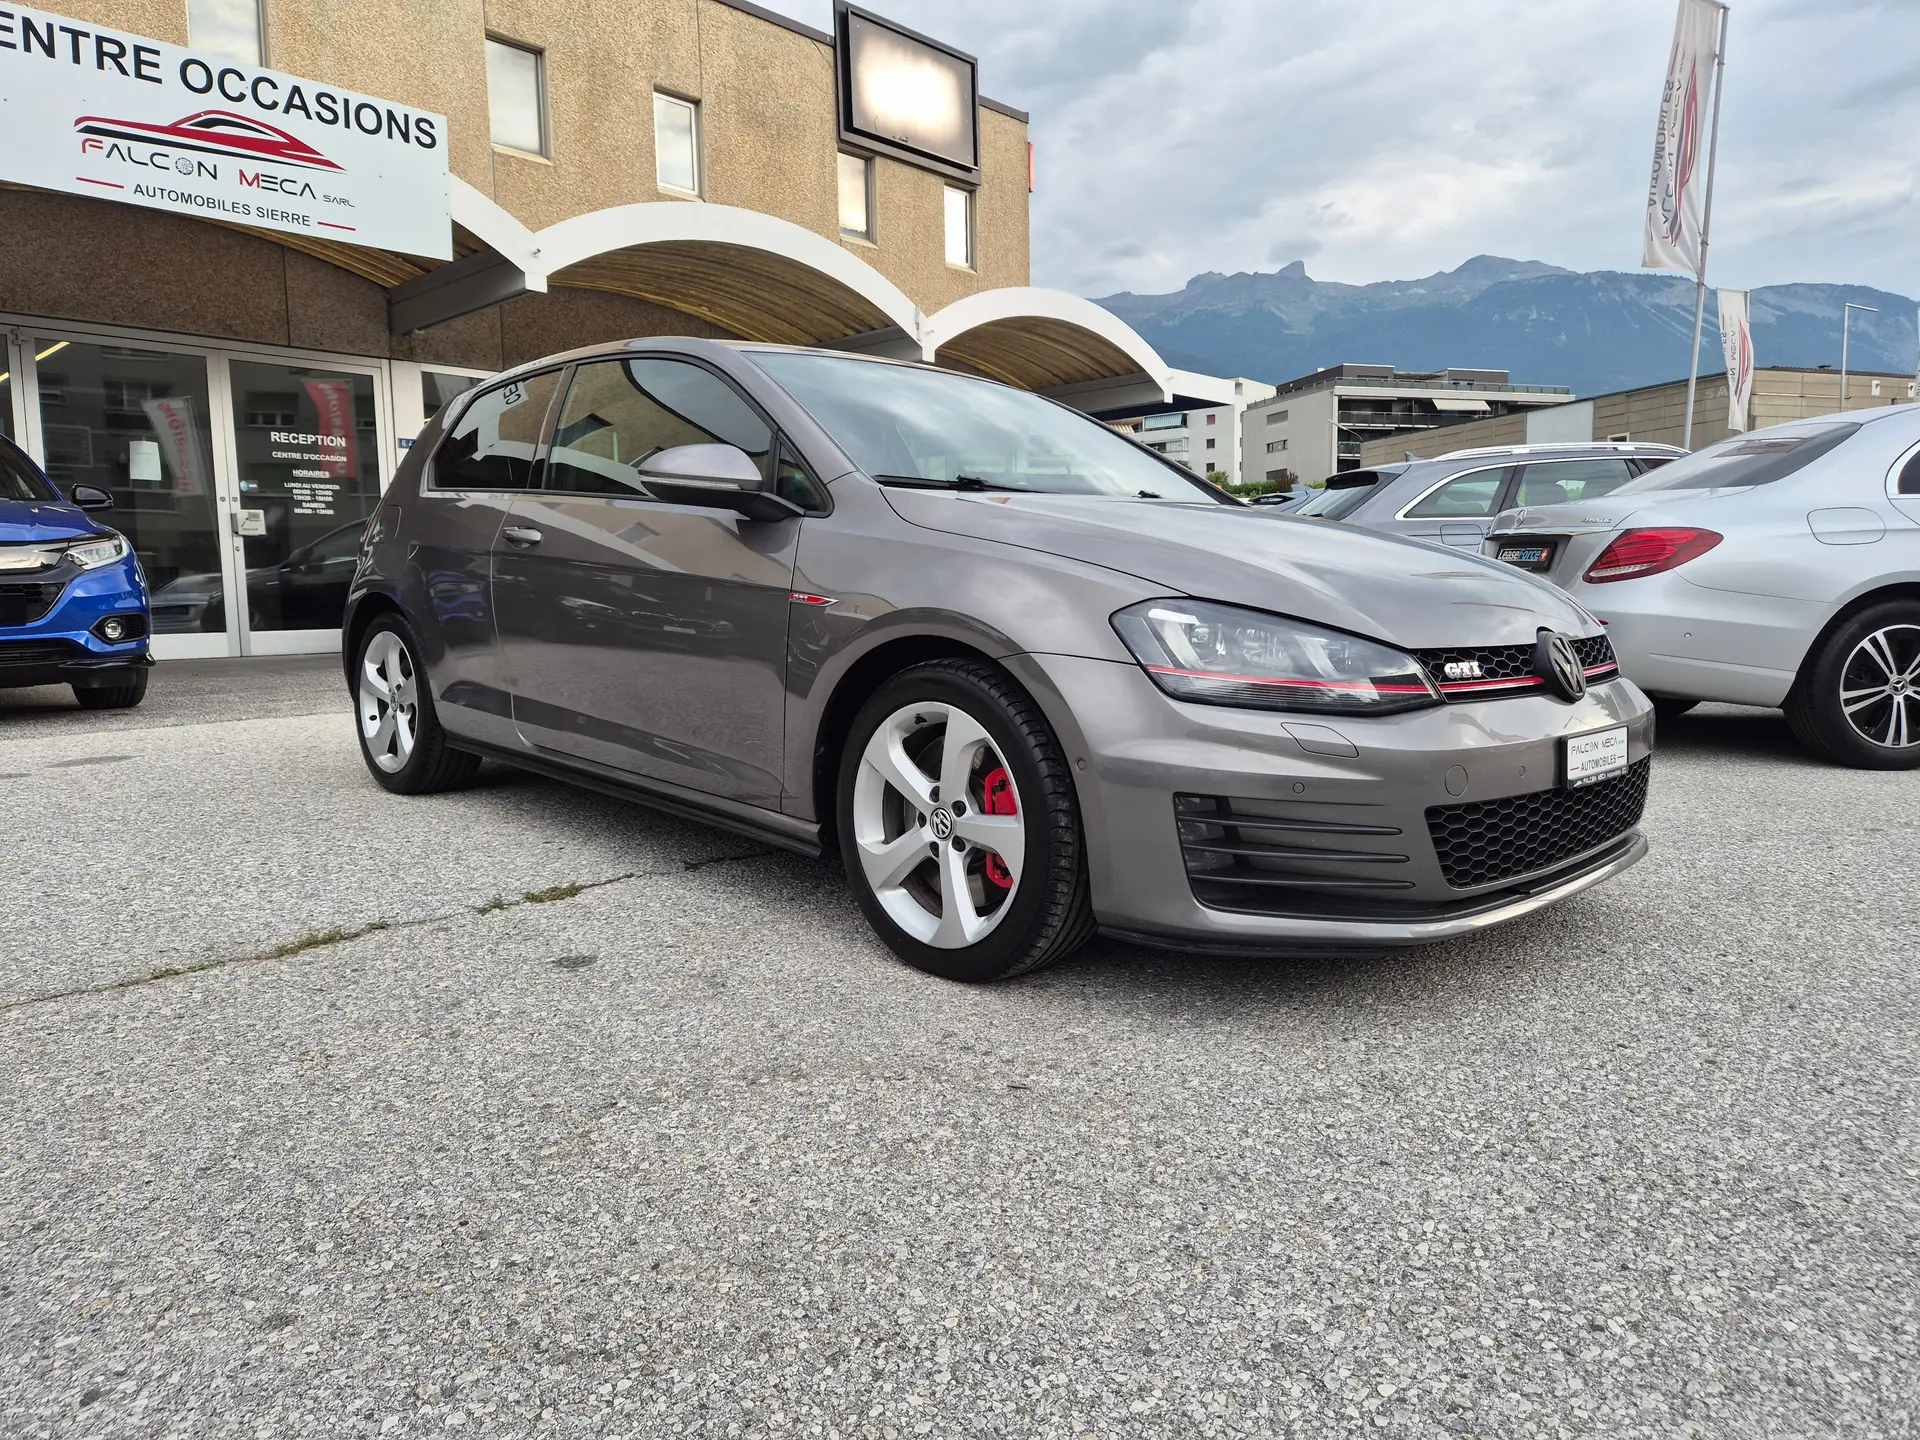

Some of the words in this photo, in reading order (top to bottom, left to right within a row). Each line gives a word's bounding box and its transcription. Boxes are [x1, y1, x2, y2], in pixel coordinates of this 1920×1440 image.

[0, 11, 163, 84] ENTRE
[180, 58, 437, 149] OCCASIONS
[81, 138, 218, 180] FALCON
[239, 169, 317, 200] MECA
[323, 194, 356, 208] SARL
[133, 183, 251, 216] AUTOMOBILES
[256, 206, 311, 227] SIERRE
[270, 431, 346, 447] RECEPTION
[272, 451, 302, 460] CENTRE
[303, 453, 347, 462] D'OCCASION
[292, 469, 330, 478] HORAIRES
[1498, 548, 1541, 561] LeaseForce
[1444, 661, 1482, 679] GTI
[1571, 741, 1599, 756] FALCON
[1581, 754, 1616, 772] AUTOMOBILES
